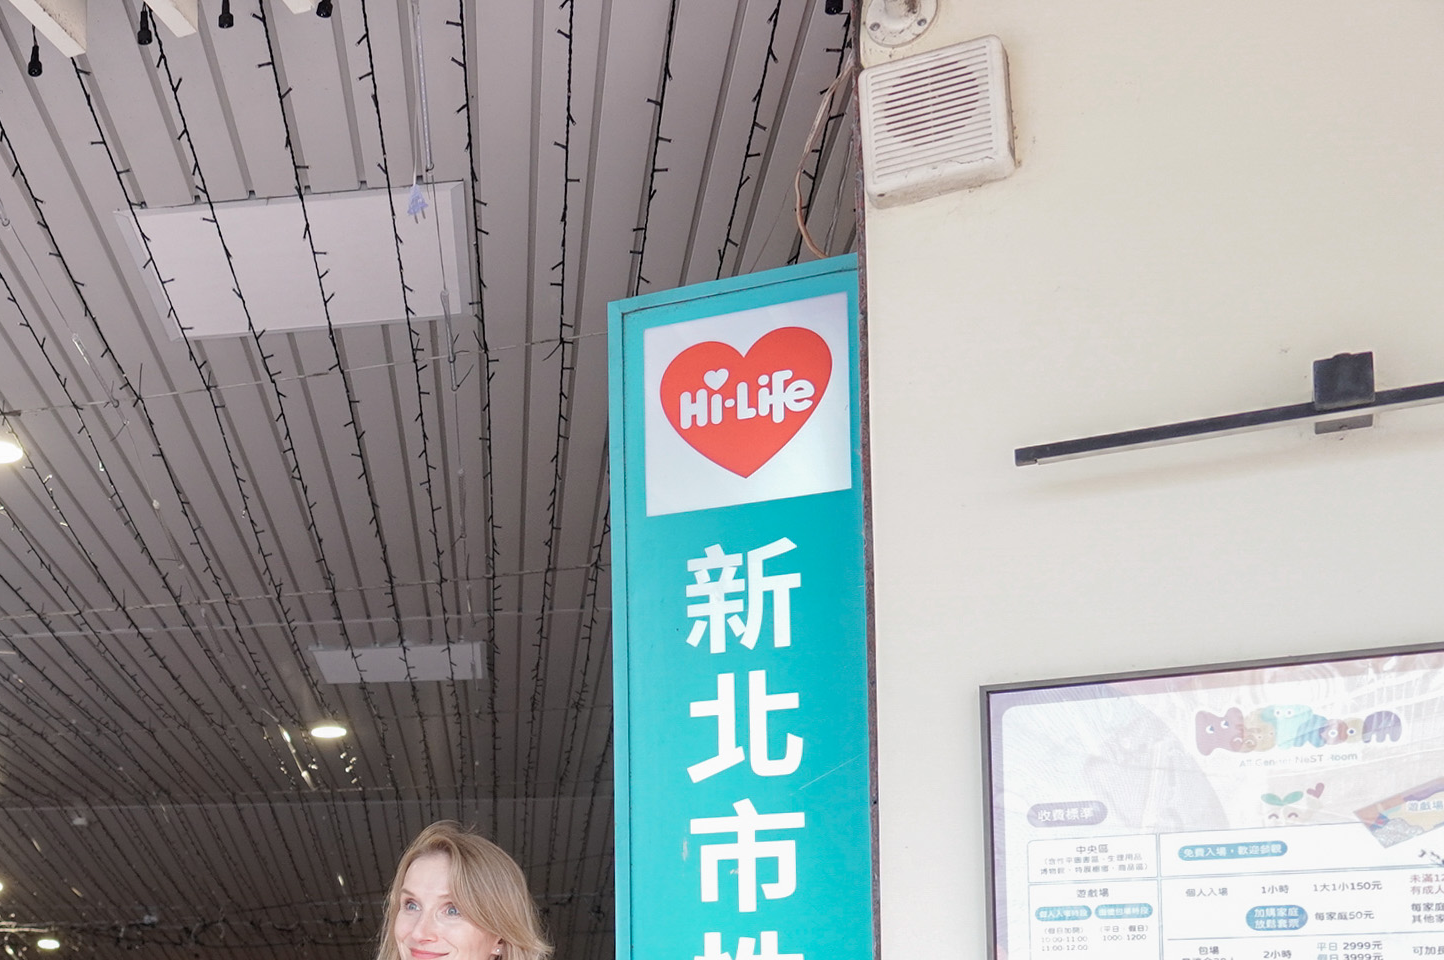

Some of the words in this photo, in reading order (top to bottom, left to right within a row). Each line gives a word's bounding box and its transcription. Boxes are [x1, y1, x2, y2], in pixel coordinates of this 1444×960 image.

[679, 368, 816, 430] Hi-Life
[1038, 807, 1094, 822] 收費標準
[1076, 844, 1109, 854] 中央區
[1261, 884, 1289, 894] 1小時
[1313, 881, 1383, 892] 1大1小150元
[1185, 887, 1229, 897] 個人入場
[1315, 911, 1375, 922] 每家庭50元
[1198, 946, 1219, 955] 包場
[1317, 942, 1338, 952] 平日
[1343, 940, 1383, 950] 2999元
[1263, 950, 1292, 959] 2小時
